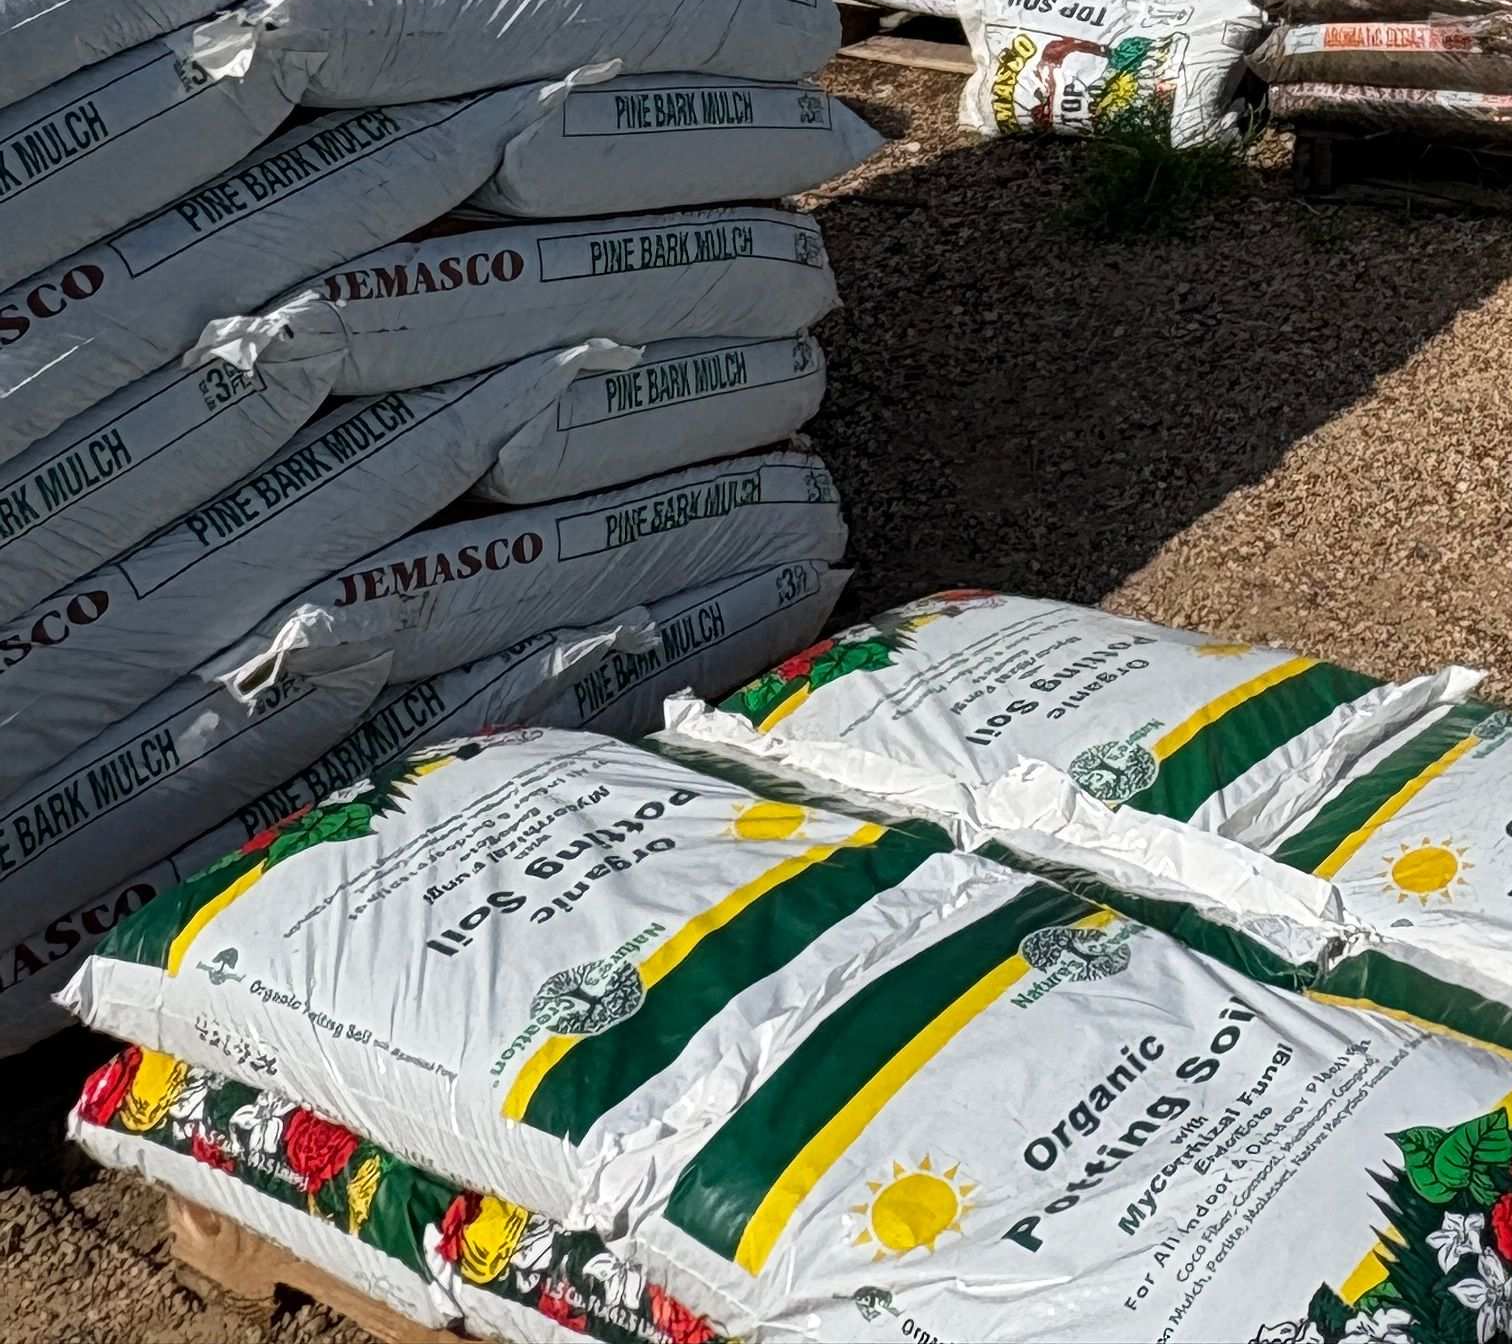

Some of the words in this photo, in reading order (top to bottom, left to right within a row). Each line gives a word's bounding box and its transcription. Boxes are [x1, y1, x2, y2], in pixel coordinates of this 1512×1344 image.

[13, 100, 109, 180] MULCH
[615, 93, 654, 130] PINE
[655, 91, 699, 127] BARK
[701, 90, 755, 127] MULCH
[176, 179, 248, 233] PINE
[243, 145, 322, 202] BARK
[322, 248, 526, 303] JEMASCO
[590, 238, 636, 276] PINE
[638, 231, 690, 270] BARK
[605, 374, 645, 415] PINE
[647, 364, 694, 406] BARK
[694, 349, 749, 397] MULCH
[35, 427, 133, 513] MULCH
[186, 488, 261, 547] PINE
[255, 448, 335, 510] BARK
[322, 393, 419, 465] MULCH
[334, 531, 545, 608] JEMASCO
[605, 508, 648, 549] PINE
[572, 663, 611, 719] PINE
[660, 601, 726, 662] MULCH
[1030, 634, 1158, 694] Potting
[1046, 658, 1151, 720] Organic
[965, 698, 1041, 747] Soil
[13, 778, 92, 857] BARK
[85, 728, 182, 810] MULCH
[525, 788, 701, 881] Potting
[426, 889, 528, 959] Soil
[529, 835, 677, 926] Organic
[1001, 1094, 1191, 1253] Potting
[1174, 995, 1259, 1085] Soil
[1023, 1032, 1165, 1173] Organic
[1117, 1099, 1242, 1238] Mycorrhizal
[1238, 1042, 1296, 1108] Fungi
[1170, 1114, 1209, 1149] with
[1124, 1272, 1153, 1313] For
[1154, 1237, 1182, 1267] All
[1176, 1175, 1235, 1237] Indoor
[1175, 1244, 1208, 1284] Coco
